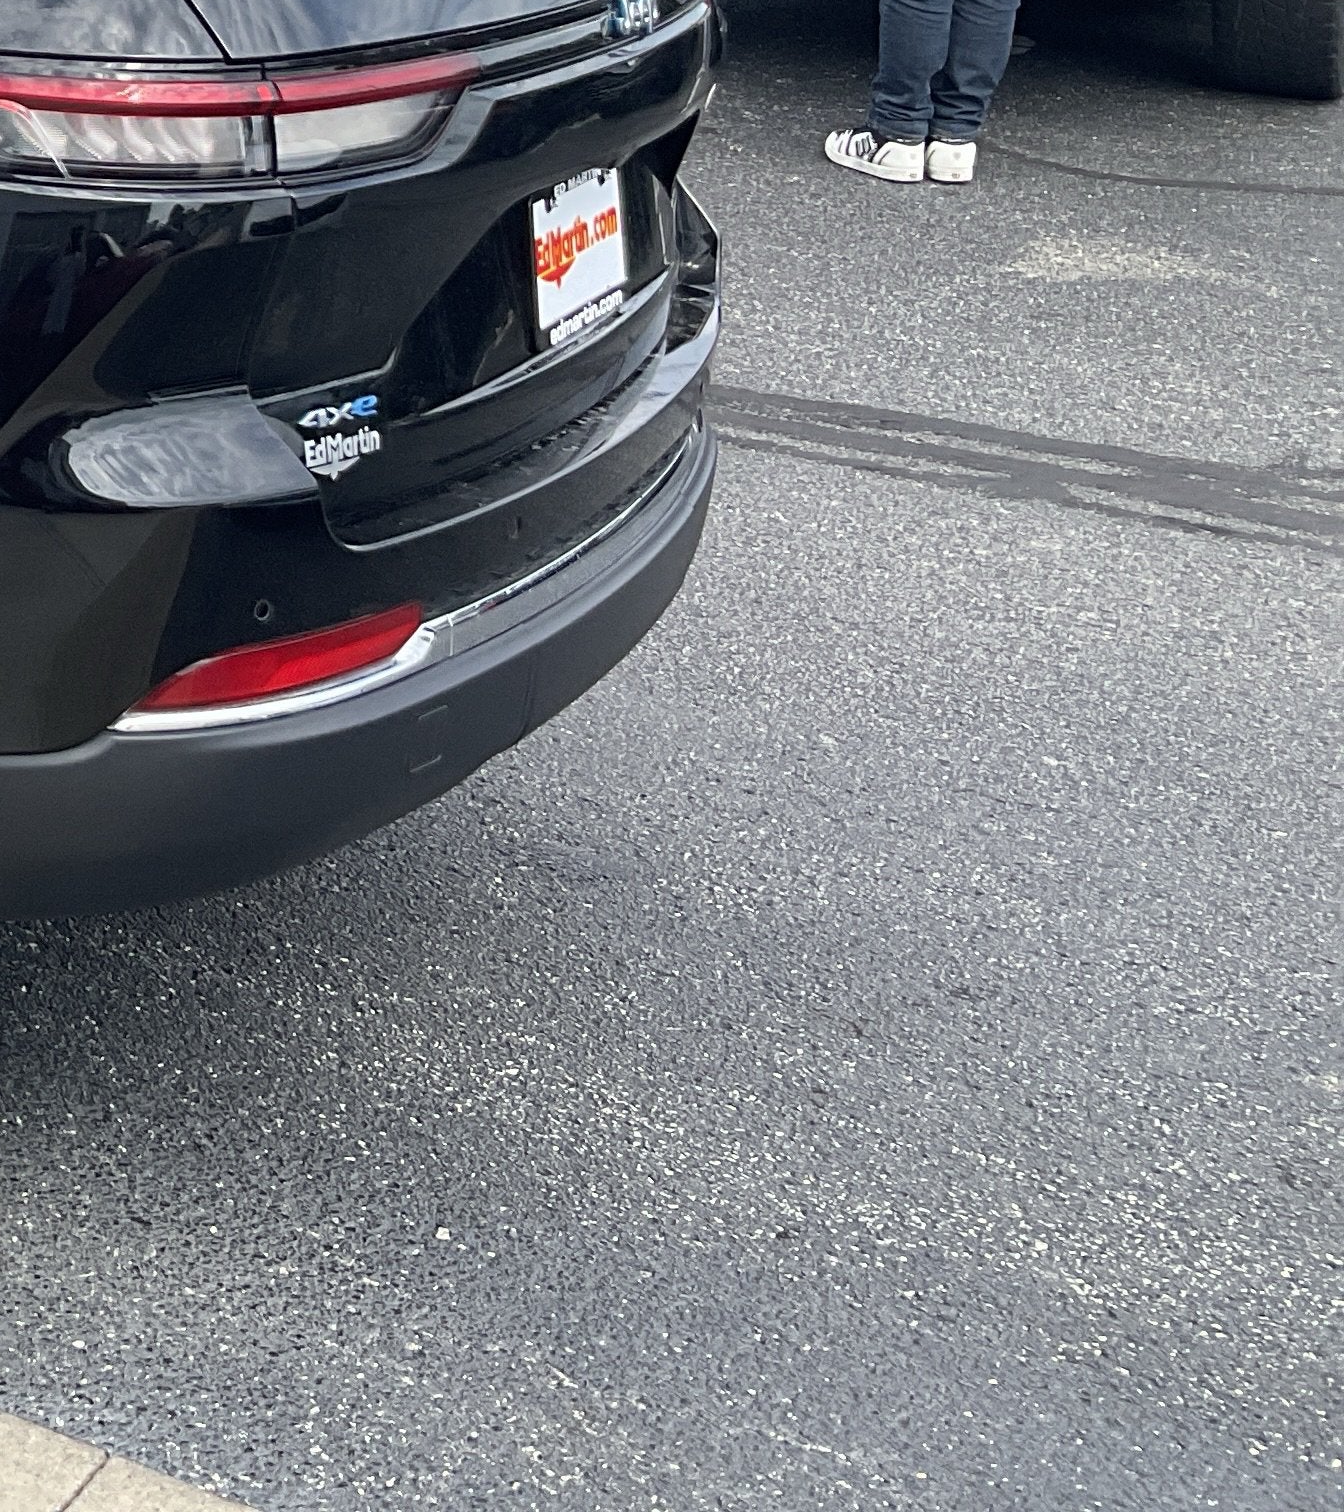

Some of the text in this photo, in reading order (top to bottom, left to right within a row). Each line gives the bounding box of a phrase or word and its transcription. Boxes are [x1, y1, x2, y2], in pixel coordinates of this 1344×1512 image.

[534, 205, 618, 276] EdMartin.com
[550, 289, 623, 346] edmartin.com
[303, 426, 381, 470] EdMartin
